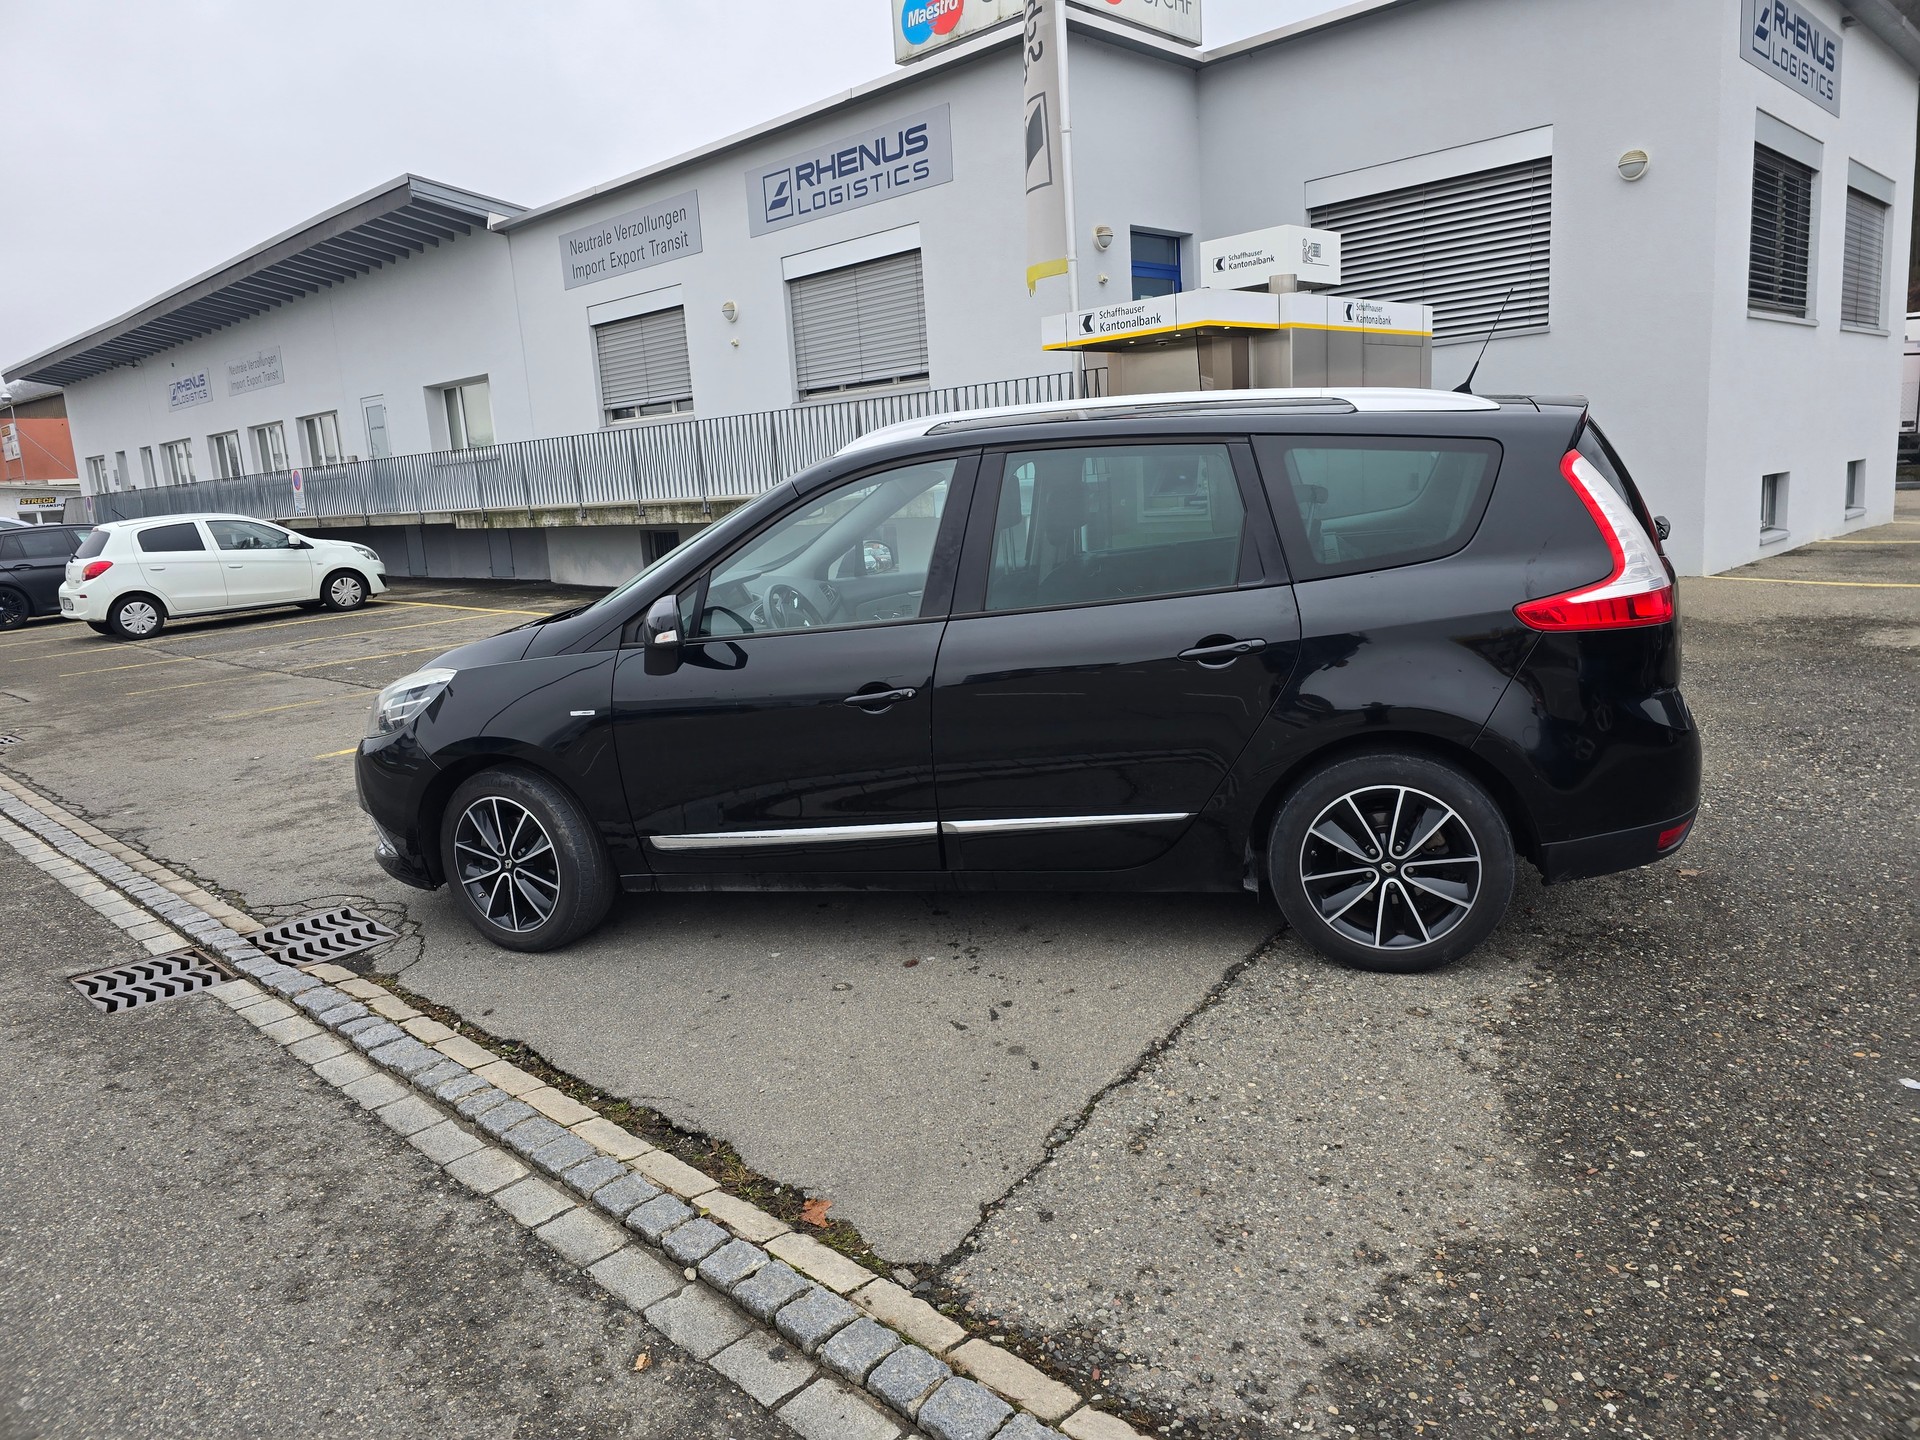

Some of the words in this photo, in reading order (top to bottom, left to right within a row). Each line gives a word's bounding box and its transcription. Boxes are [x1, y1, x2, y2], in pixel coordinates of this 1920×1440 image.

[907, 0, 958, 27] Maestro
[1774, 0, 1835, 72] RHENUS
[1773, 41, 1833, 100] LOGISTICS
[795, 123, 929, 191] RHENUS
[798, 158, 930, 215] LOGISTICS
[570, 223, 612, 256] Neutrale
[614, 207, 687, 240] Verzollungen
[572, 256, 606, 280] Import
[610, 244, 646, 271] Export
[649, 230, 689, 256] Transit
[1228, 250, 1263, 262] Schaffhauser
[1228, 254, 1275, 270] Kantonalbank
[1099, 305, 1145, 319] Schaffhauser
[1356, 302, 1383, 313] Schaffhauser
[1099, 312, 1162, 332] Kantonalbank
[1356, 314, 1392, 325] Kantonalbank
[176, 373, 206, 394] RHENUS
[177, 389, 208, 405] LOGISTICS
